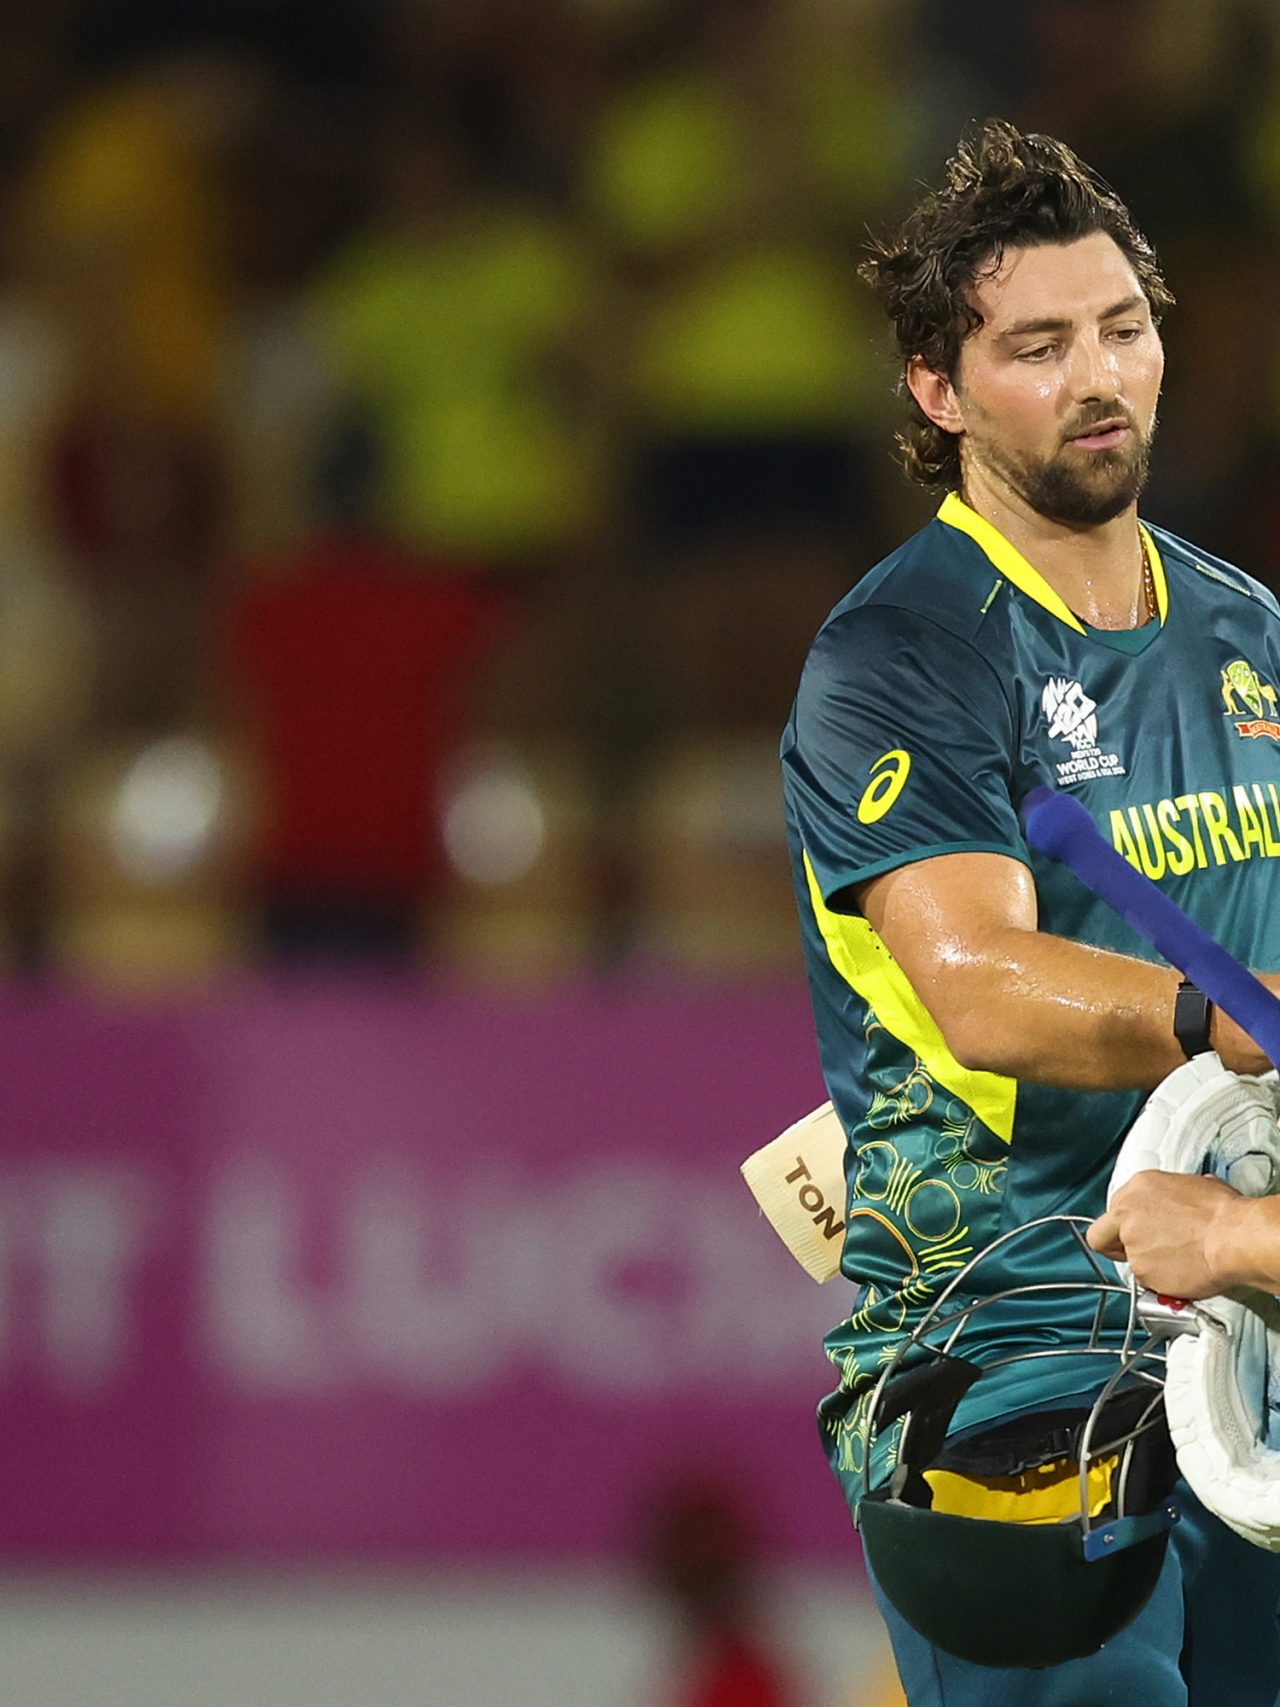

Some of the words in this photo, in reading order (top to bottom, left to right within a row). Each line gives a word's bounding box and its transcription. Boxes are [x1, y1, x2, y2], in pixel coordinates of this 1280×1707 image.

[1056, 757, 1099, 776] WORLD
[1098, 753, 1119, 768] CUP
[785, 1155, 846, 1241] TON
